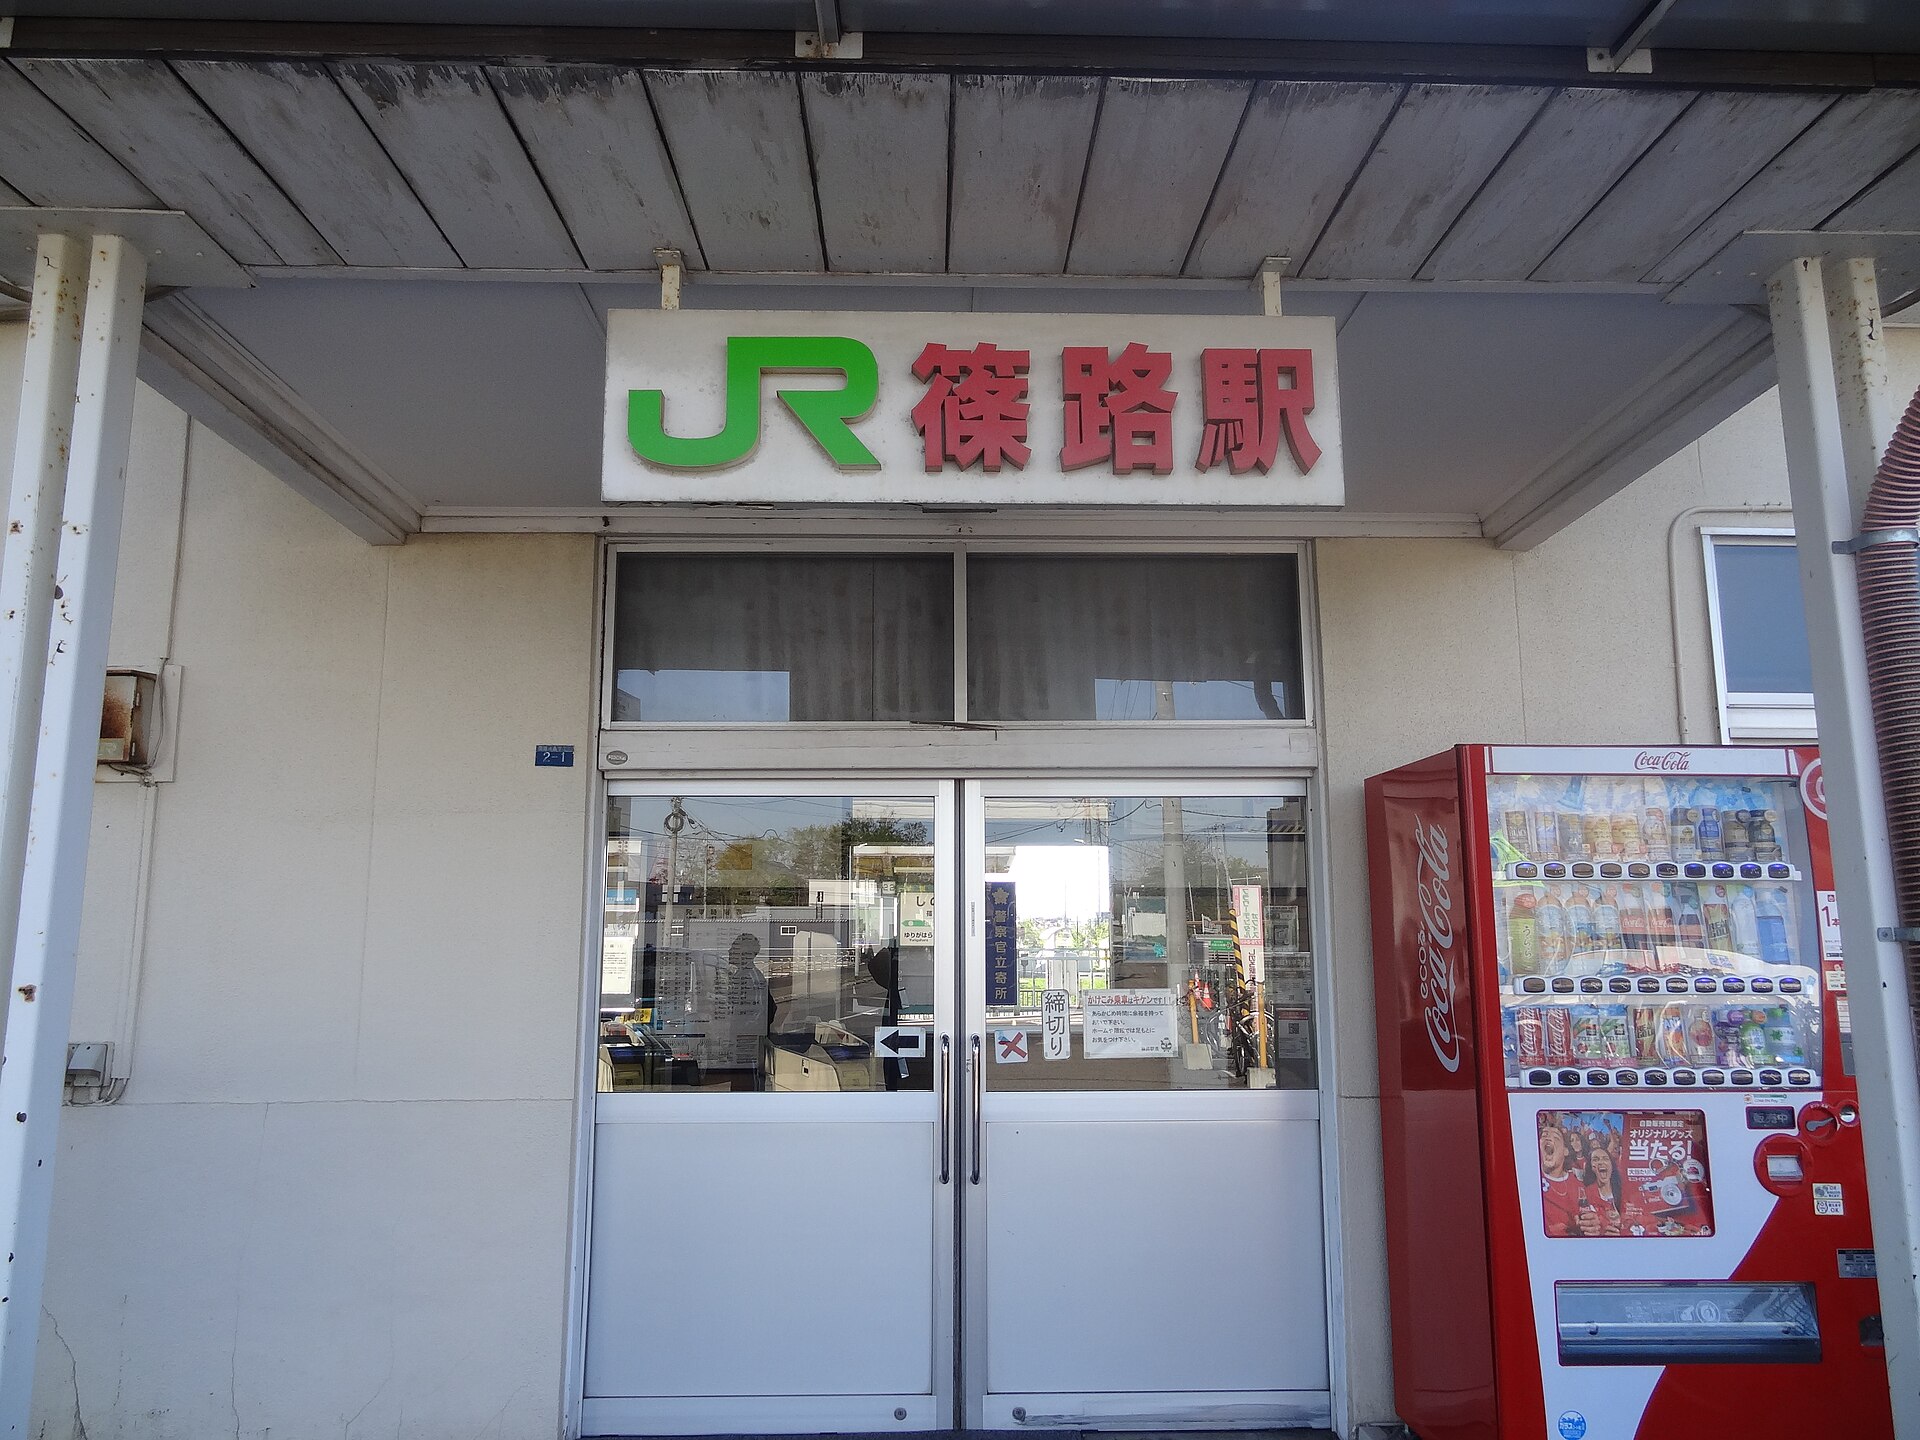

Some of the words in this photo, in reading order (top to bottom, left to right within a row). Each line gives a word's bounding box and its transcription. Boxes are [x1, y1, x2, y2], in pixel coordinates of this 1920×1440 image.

[628, 336, 881, 470] JR
[911, 341, 1322, 476] 篠路駅
[542, 751, 566, 763] 2-1
[1634, 750, 1692, 771] Coca-Cola
[904, 931, 933, 939] ゆりがはら
[1415, 813, 1460, 1073] Coca-Cola
[992, 909, 1009, 1000] 警察官立寄所
[1044, 991, 1066, 1056] 締切り
[1629, 1129, 1693, 1139] オリジナルグッズ
[1629, 1139, 1692, 1160] 当たる!
